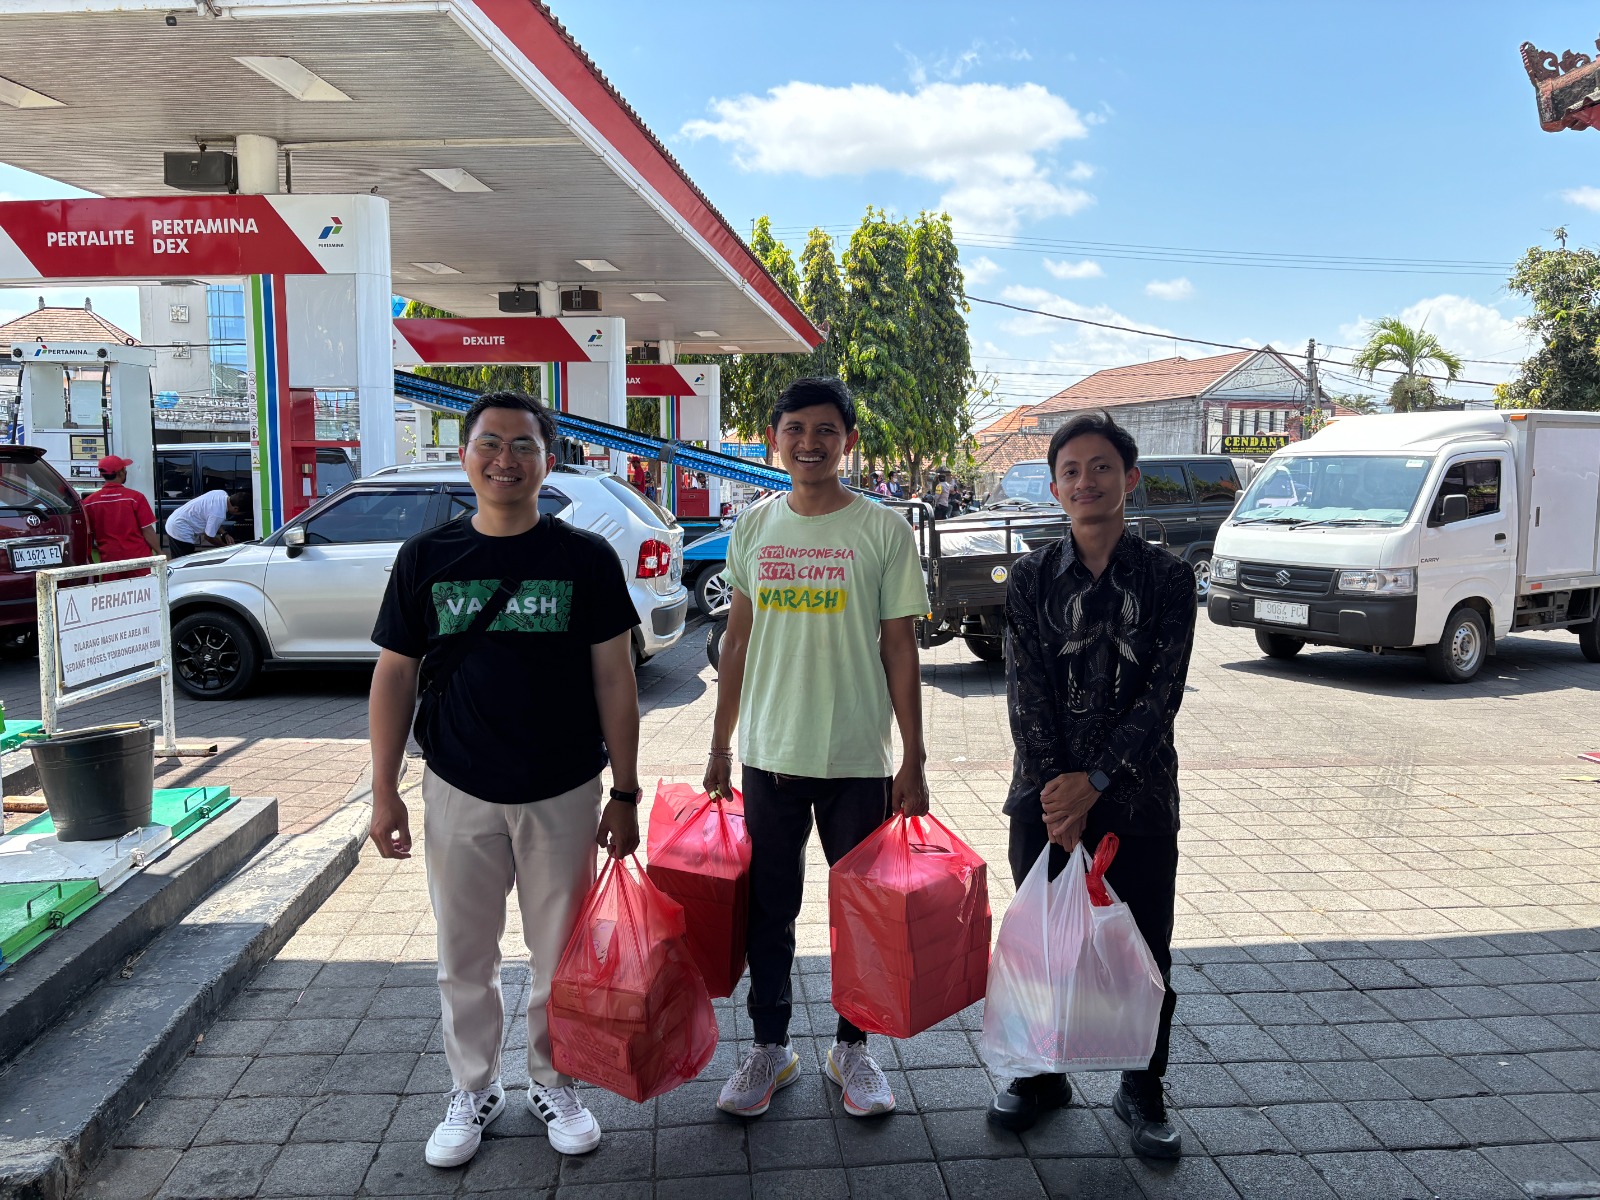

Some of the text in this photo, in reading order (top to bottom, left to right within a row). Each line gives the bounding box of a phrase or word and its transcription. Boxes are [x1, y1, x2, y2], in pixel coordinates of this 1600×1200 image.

[152, 218, 259, 235] PERTAMINA
[47, 230, 134, 247] PERTALITE
[153, 238, 190, 254] DEX
[462, 336, 506, 346] DEXLITE
[1224, 436, 1286, 447] CENDANA
[14, 547, 60, 562] DK 1671 FZ
[91, 588, 151, 612] PERHATIAN
[446, 596, 558, 616] VAASH
[759, 588, 840, 609] VARASH
[73, 625, 150, 653] DILARANG MASUK KE AREA INI
[65, 660, 86, 674] SEDANG
[86, 653, 108, 667] PROSES
